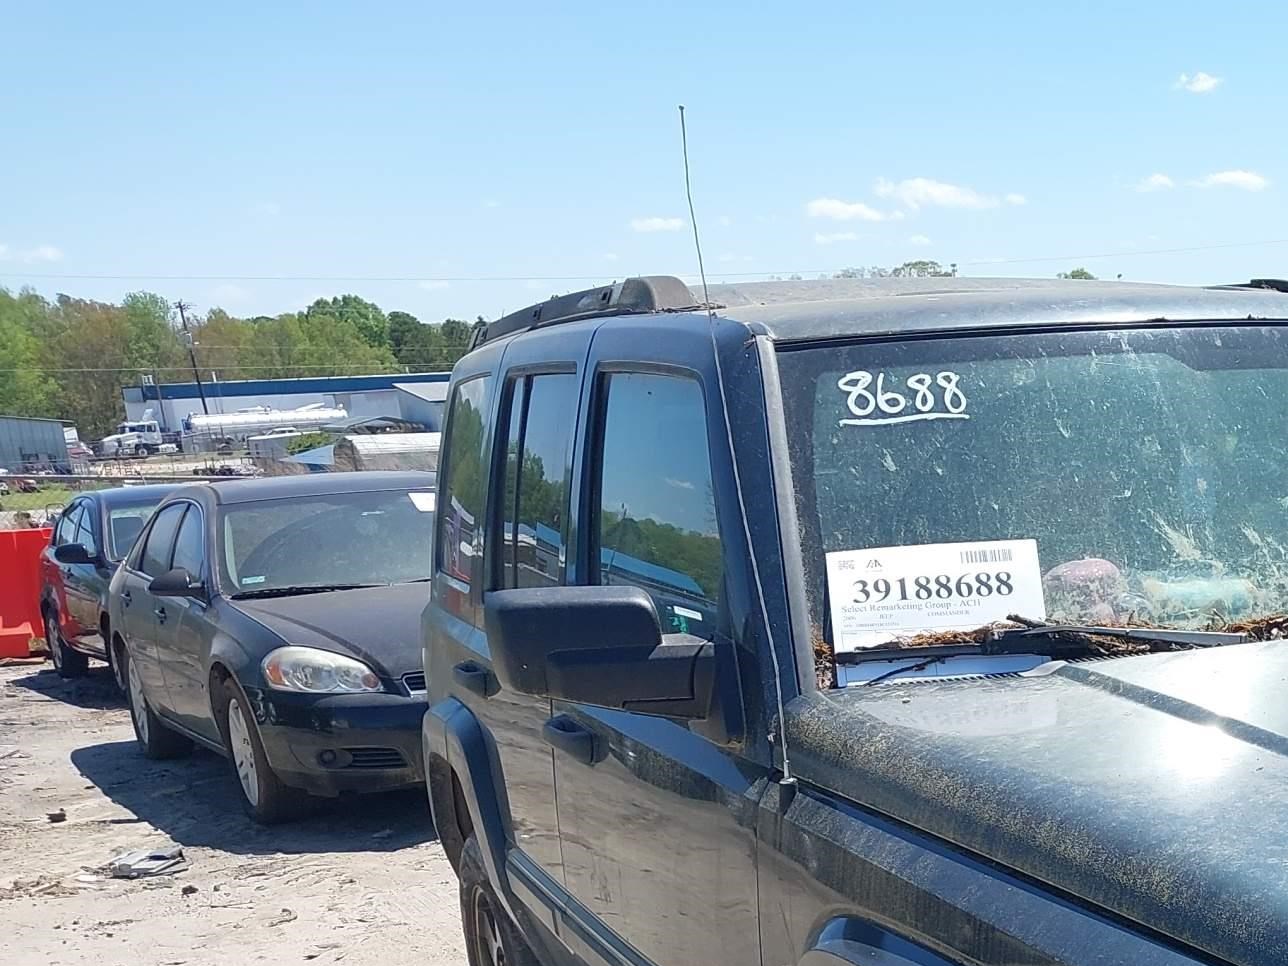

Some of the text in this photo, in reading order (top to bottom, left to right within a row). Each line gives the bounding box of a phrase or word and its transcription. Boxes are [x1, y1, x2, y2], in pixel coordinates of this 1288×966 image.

[838, 370, 967, 416] 8688
[853, 571, 1014, 604] 39188688
[841, 604, 867, 613] Select
[869, 602, 923, 612] Remarketing
[925, 601, 951, 609] Group
